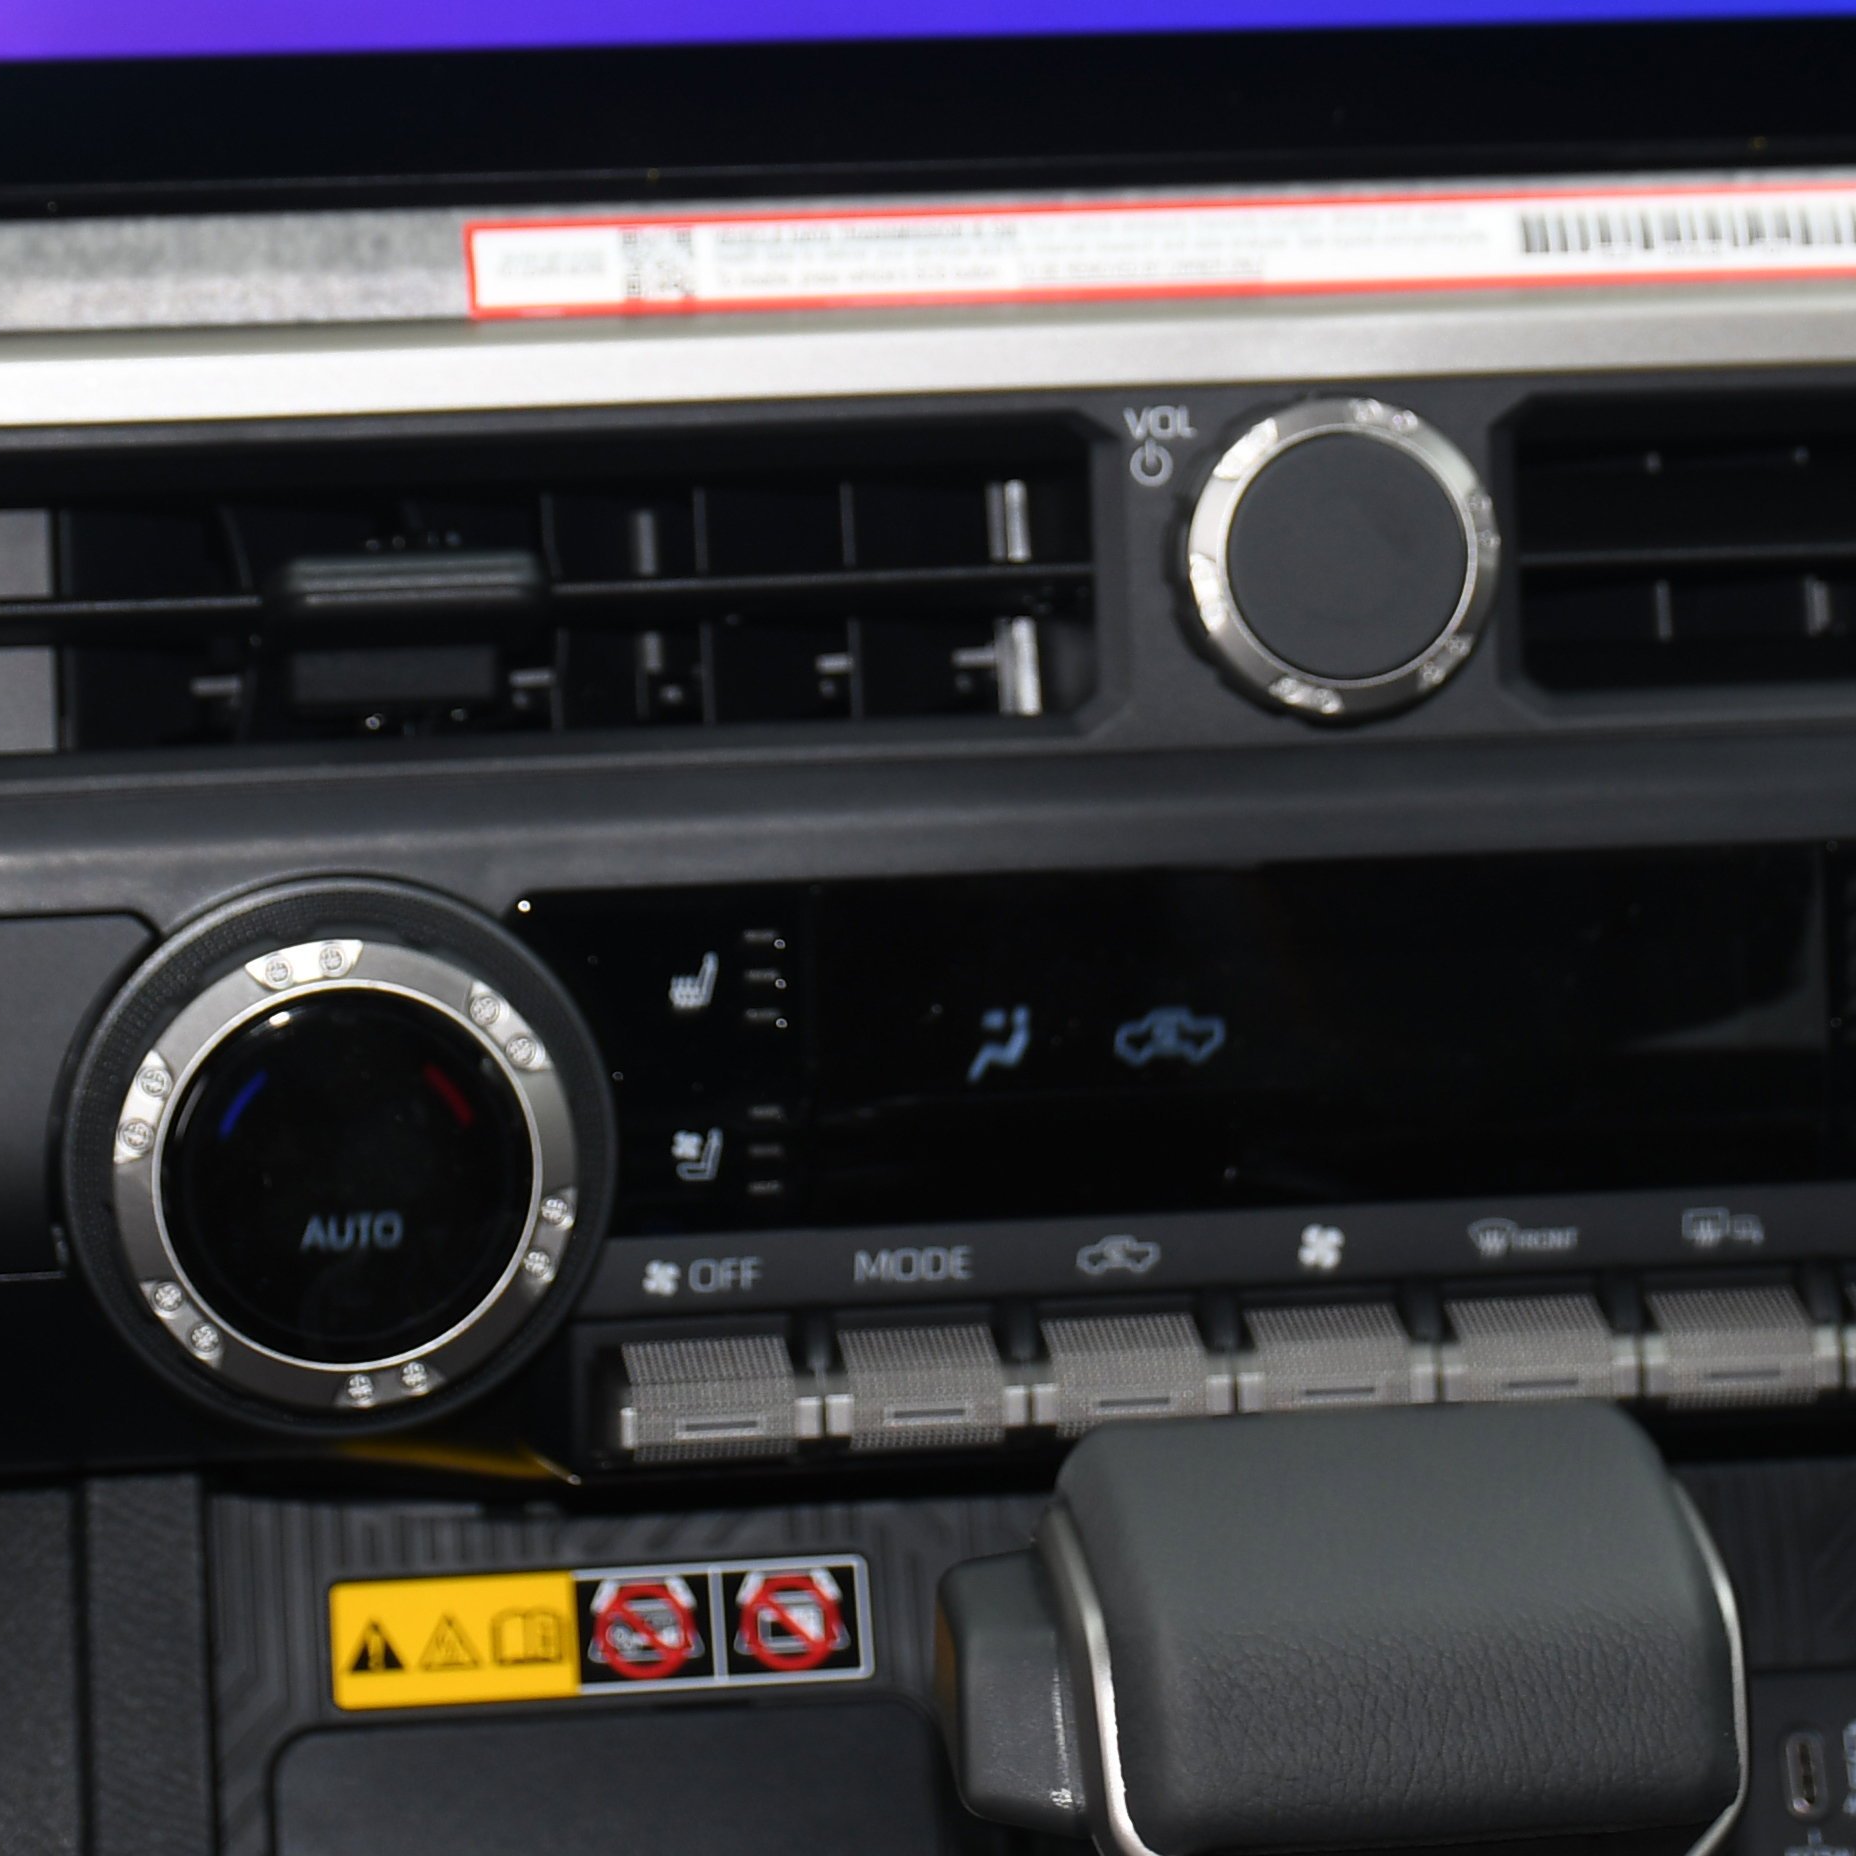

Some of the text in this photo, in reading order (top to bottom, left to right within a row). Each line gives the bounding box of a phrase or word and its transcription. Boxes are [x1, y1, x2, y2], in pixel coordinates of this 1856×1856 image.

[1123, 404, 1198, 439] VOL
[300, 1210, 404, 1251] AUTO
[687, 1256, 762, 1293] OFF
[853, 1245, 973, 1282] MODE
